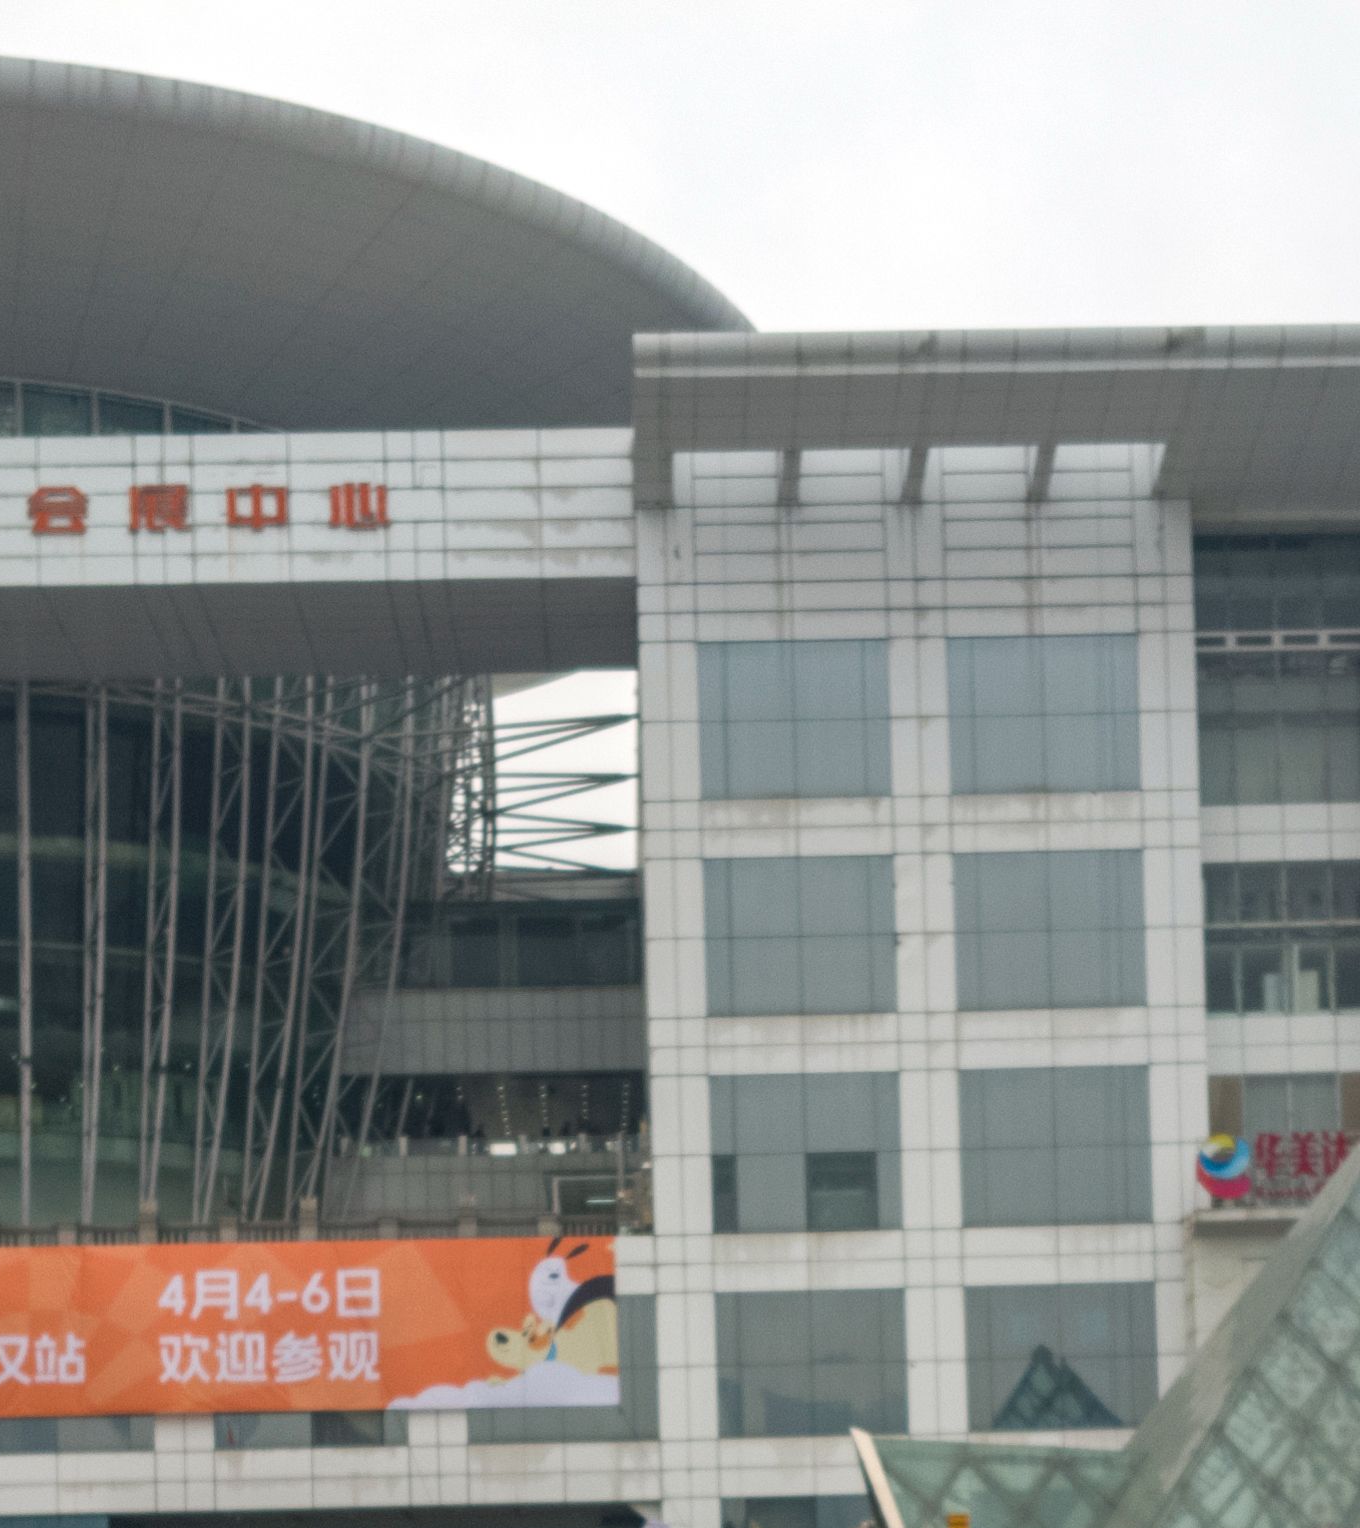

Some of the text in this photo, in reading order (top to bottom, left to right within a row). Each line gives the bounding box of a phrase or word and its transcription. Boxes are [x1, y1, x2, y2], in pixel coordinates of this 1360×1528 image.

[159, 1266, 382, 1321] 4月4-6日
[158, 1330, 382, 1386] 欢迎参观
